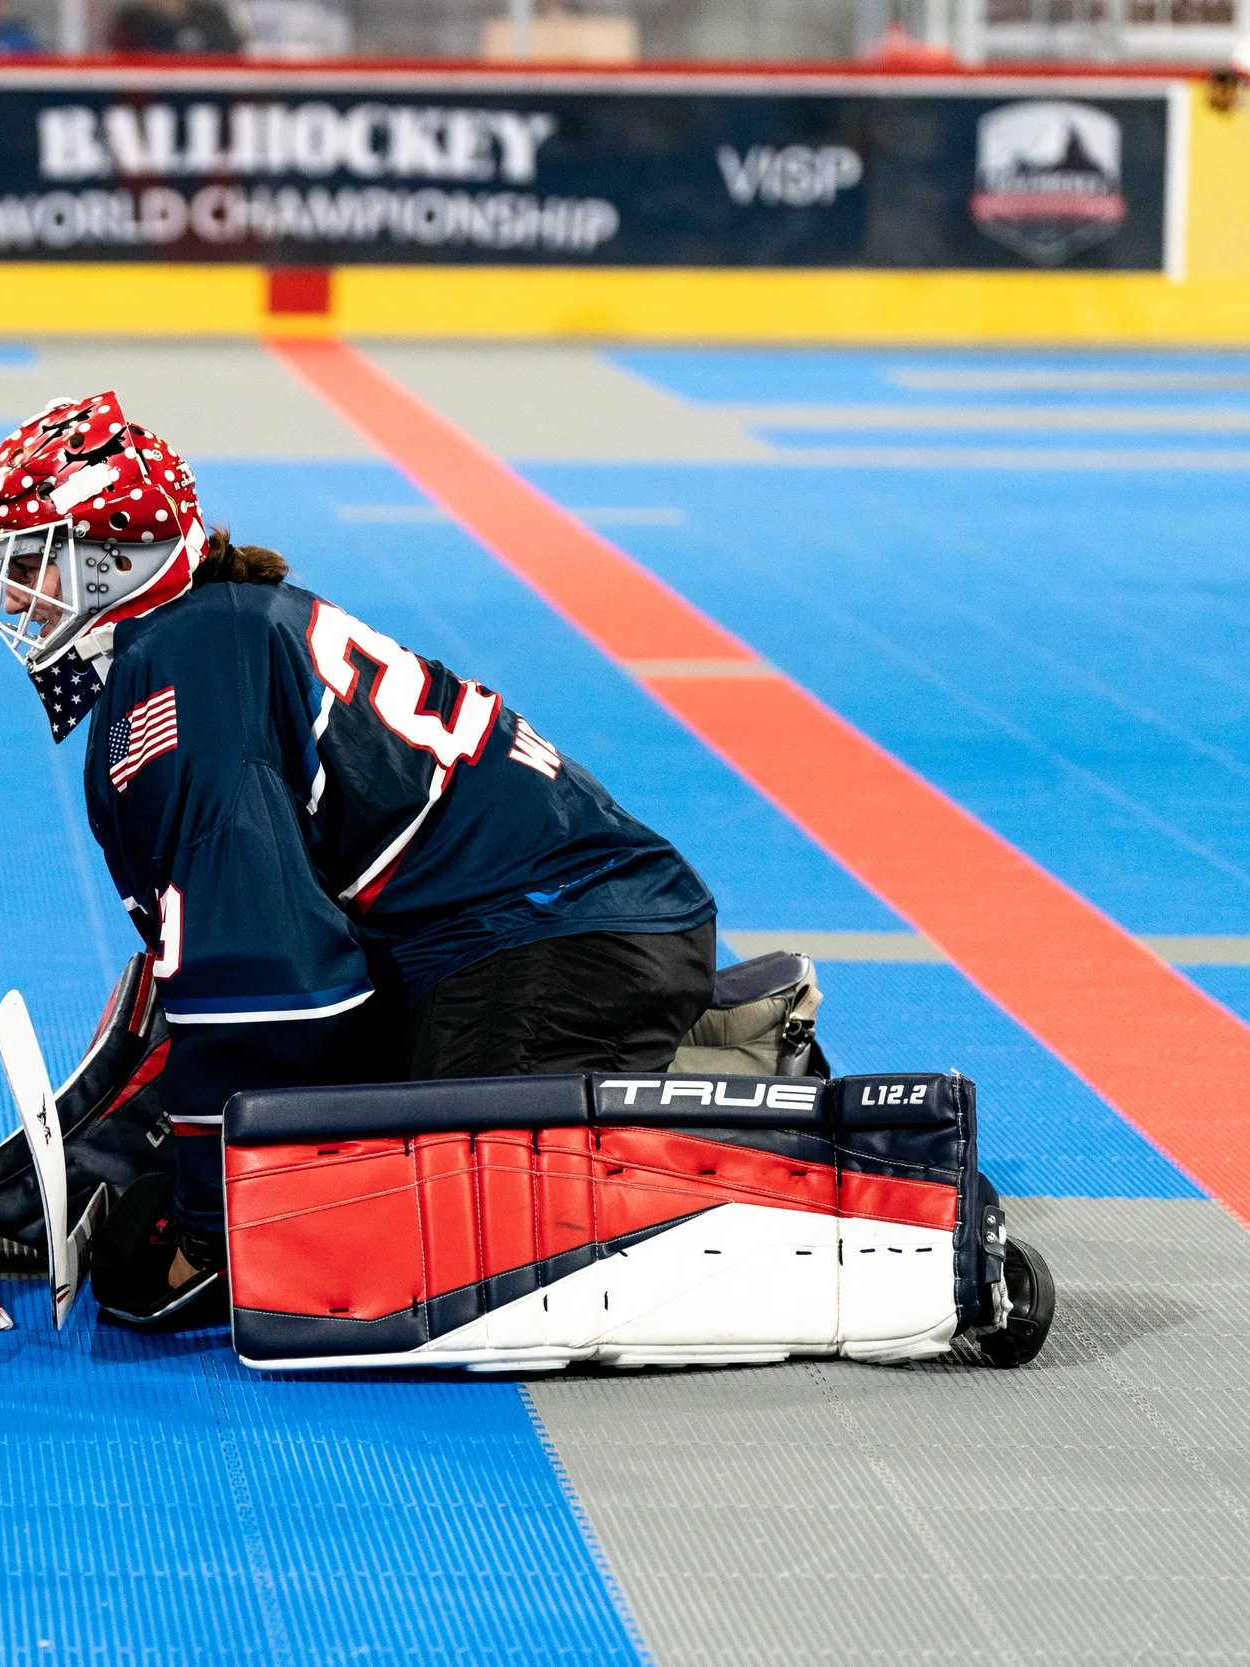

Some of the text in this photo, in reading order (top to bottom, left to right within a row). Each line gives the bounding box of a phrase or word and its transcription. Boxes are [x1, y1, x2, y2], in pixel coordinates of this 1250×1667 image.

[37, 101, 556, 185] BALLHOCKEY
[716, 143, 863, 208] VISP
[188, 186, 620, 253] CHAMPIONSHIP
[600, 1079, 928, 1111] TRUE L12.2
